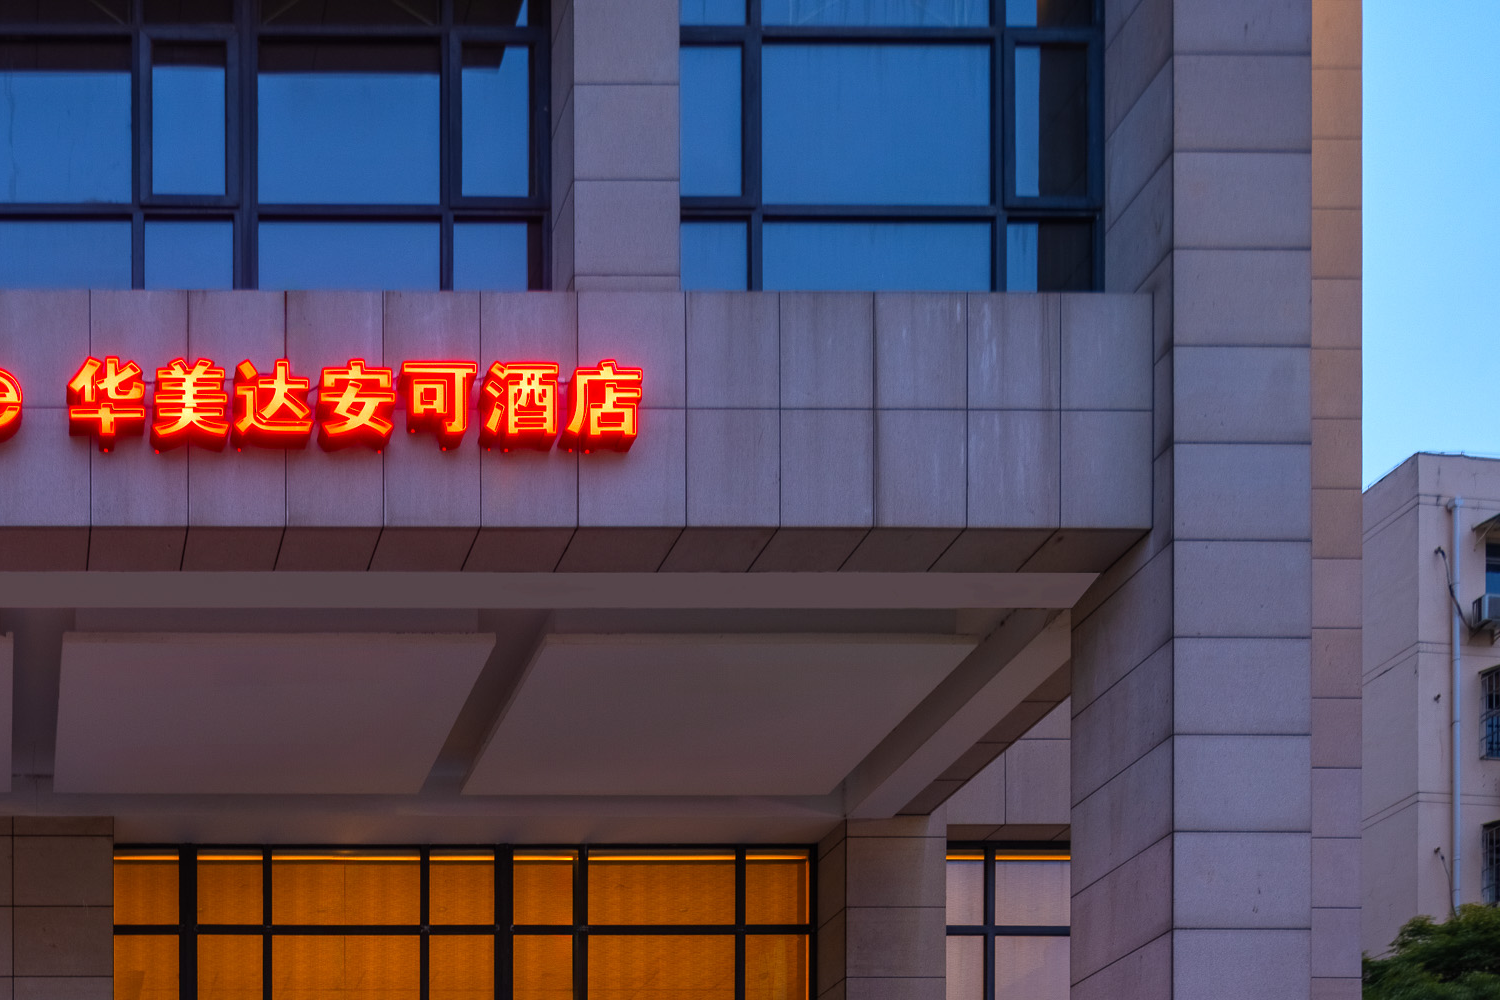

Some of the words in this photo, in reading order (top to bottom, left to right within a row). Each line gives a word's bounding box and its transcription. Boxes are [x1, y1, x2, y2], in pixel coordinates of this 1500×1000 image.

[67, 356, 644, 438] 华美达安可酒店
